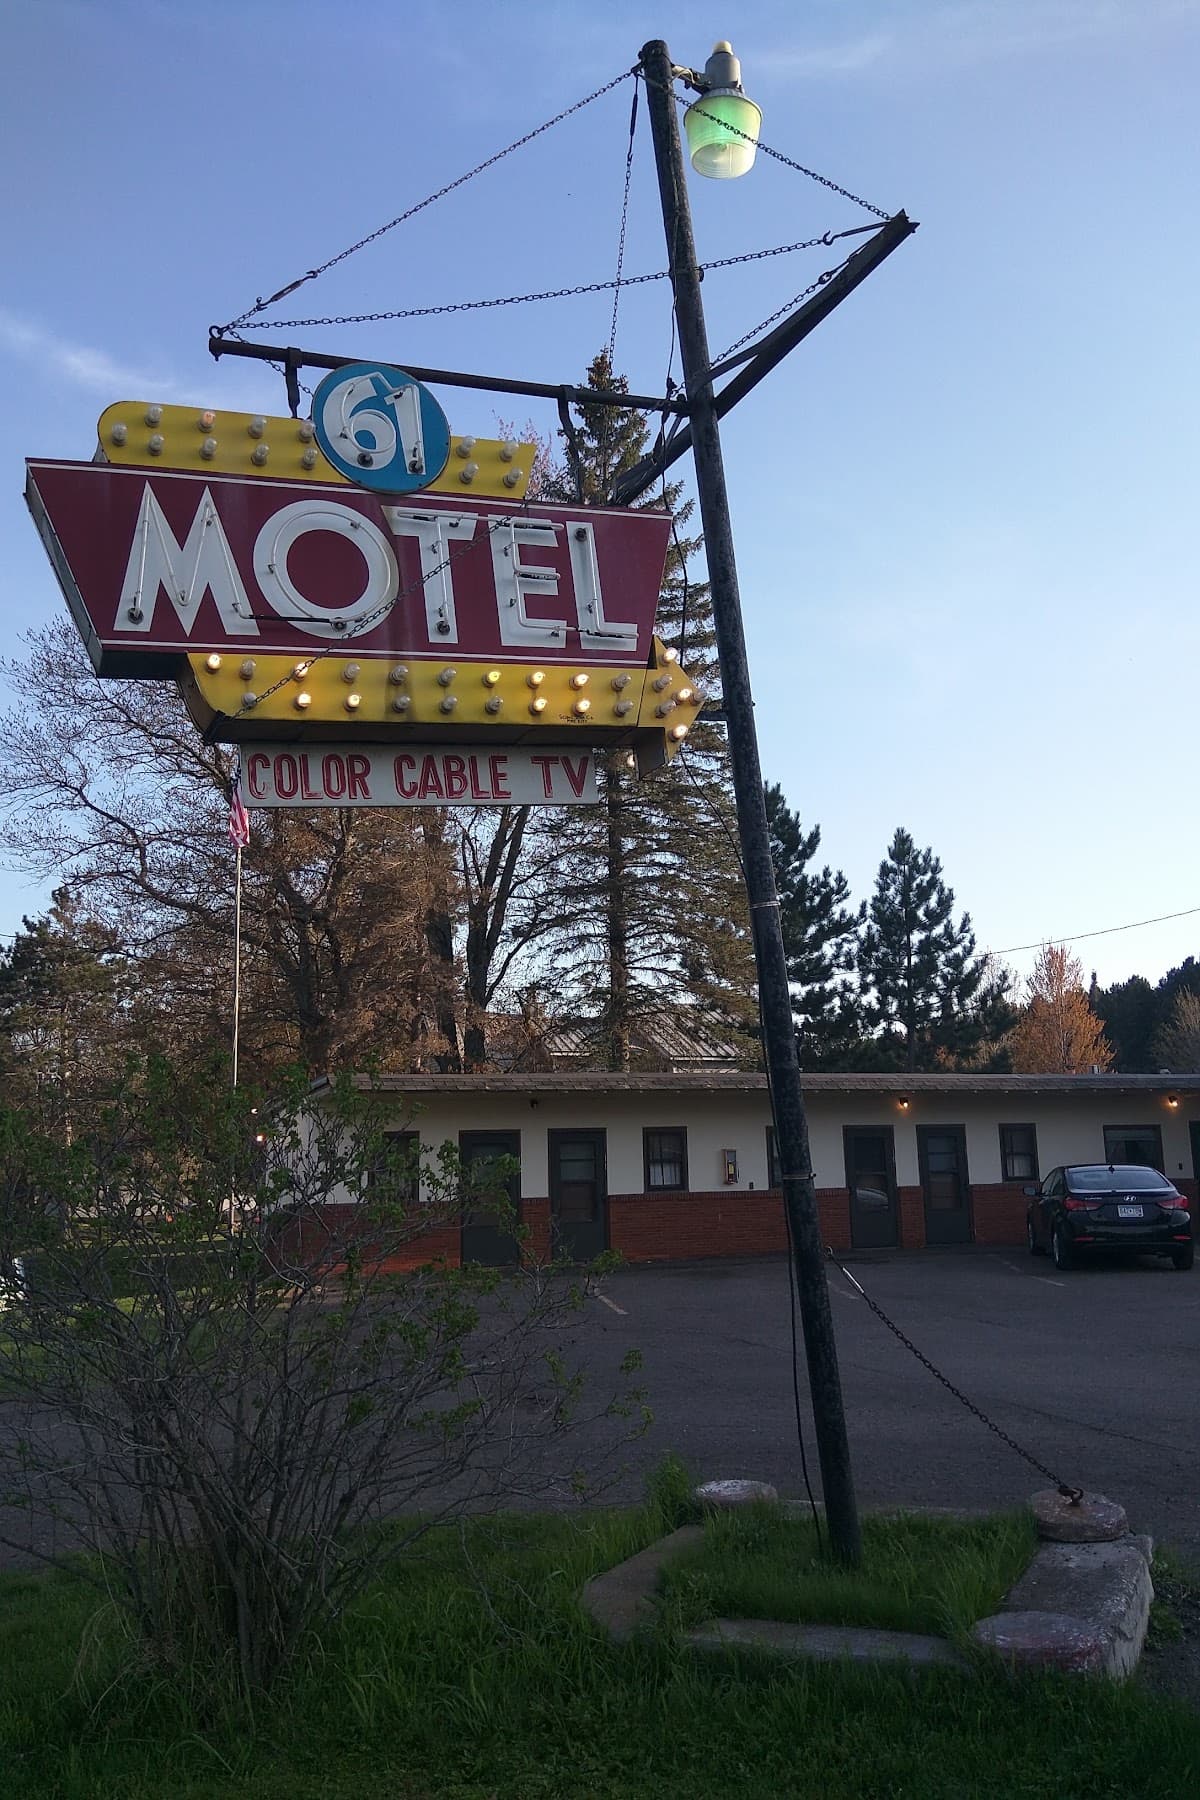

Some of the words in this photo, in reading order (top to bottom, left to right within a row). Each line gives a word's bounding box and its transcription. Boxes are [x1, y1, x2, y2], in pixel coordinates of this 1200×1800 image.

[323, 372, 426, 475] 61
[113, 481, 639, 652] MOTEL
[247, 753, 371, 800] COLOR
[394, 754, 511, 800] CABLE
[531, 755, 589, 799] TV
